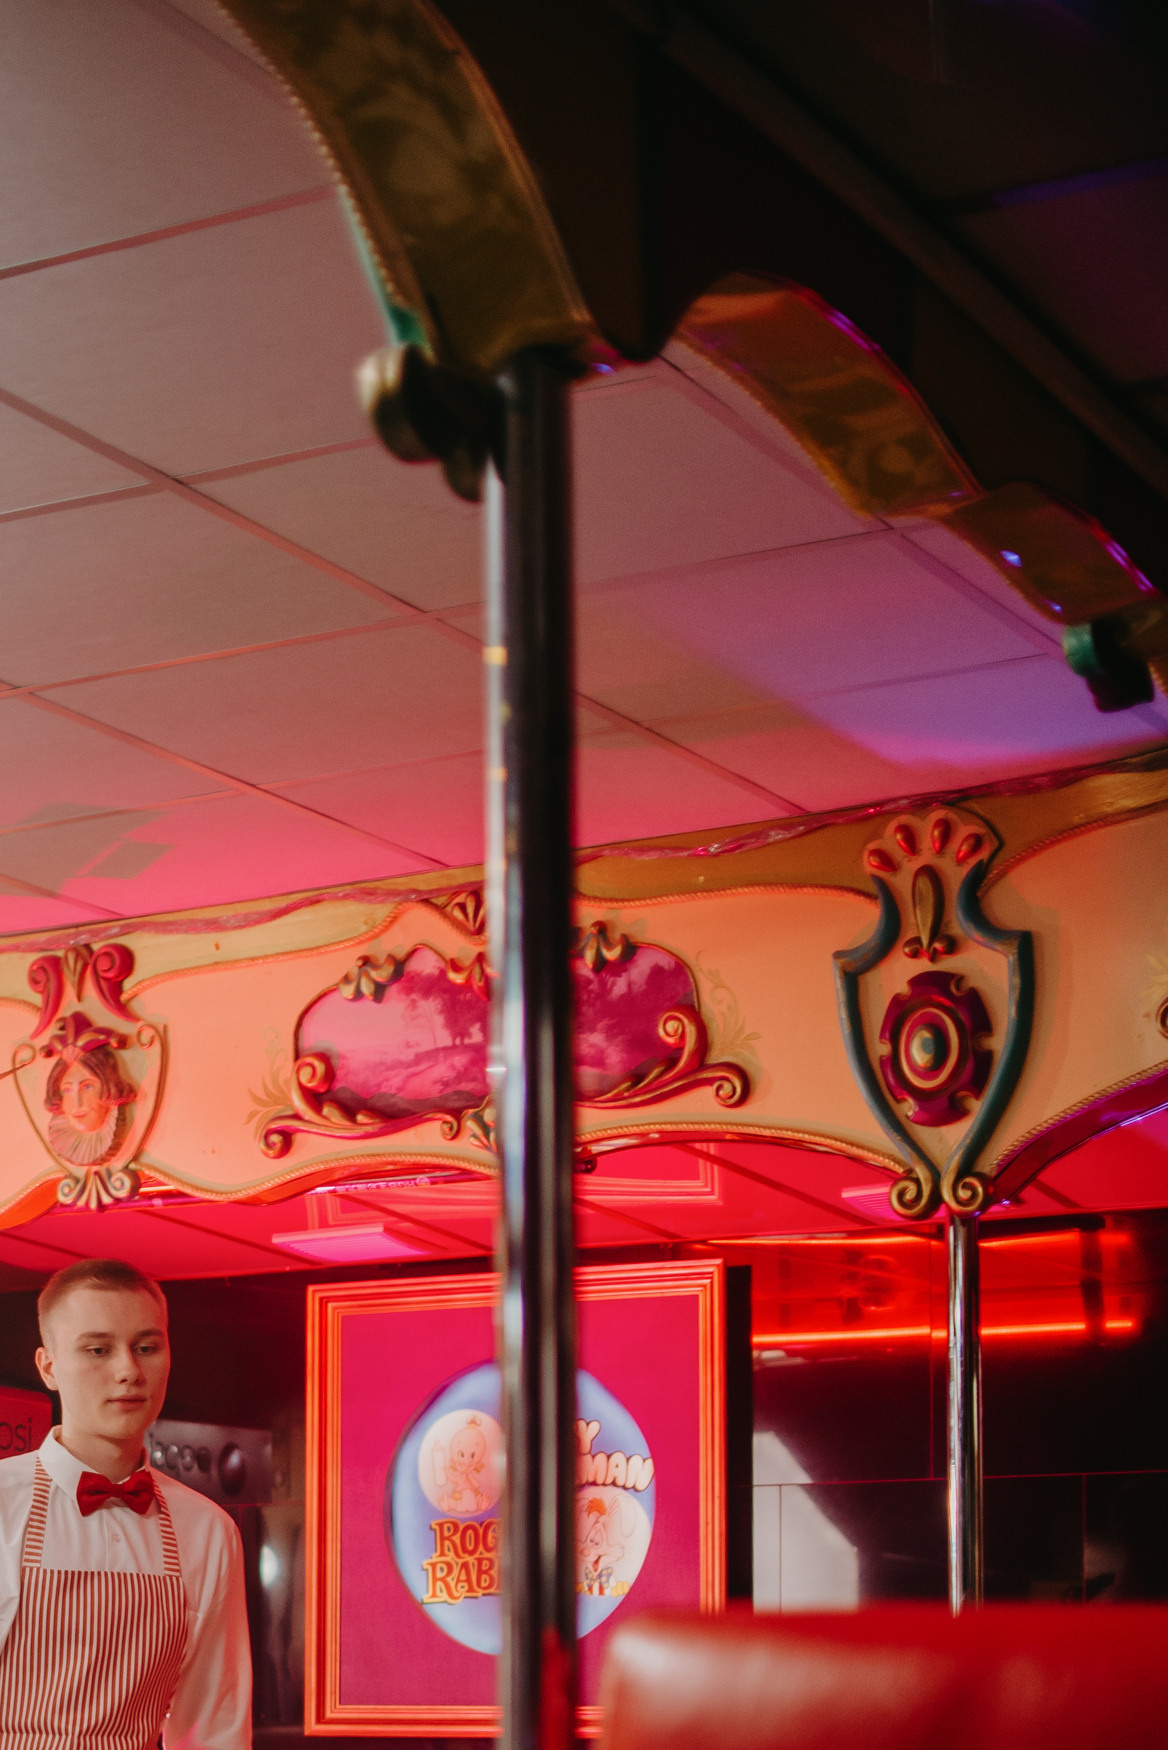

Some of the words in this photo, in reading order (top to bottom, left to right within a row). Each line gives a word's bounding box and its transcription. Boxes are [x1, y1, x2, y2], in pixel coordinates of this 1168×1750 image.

[575, 1451, 655, 1492] MAN
[430, 1518, 500, 1560] ROG
[422, 1557, 500, 1604] RAB
